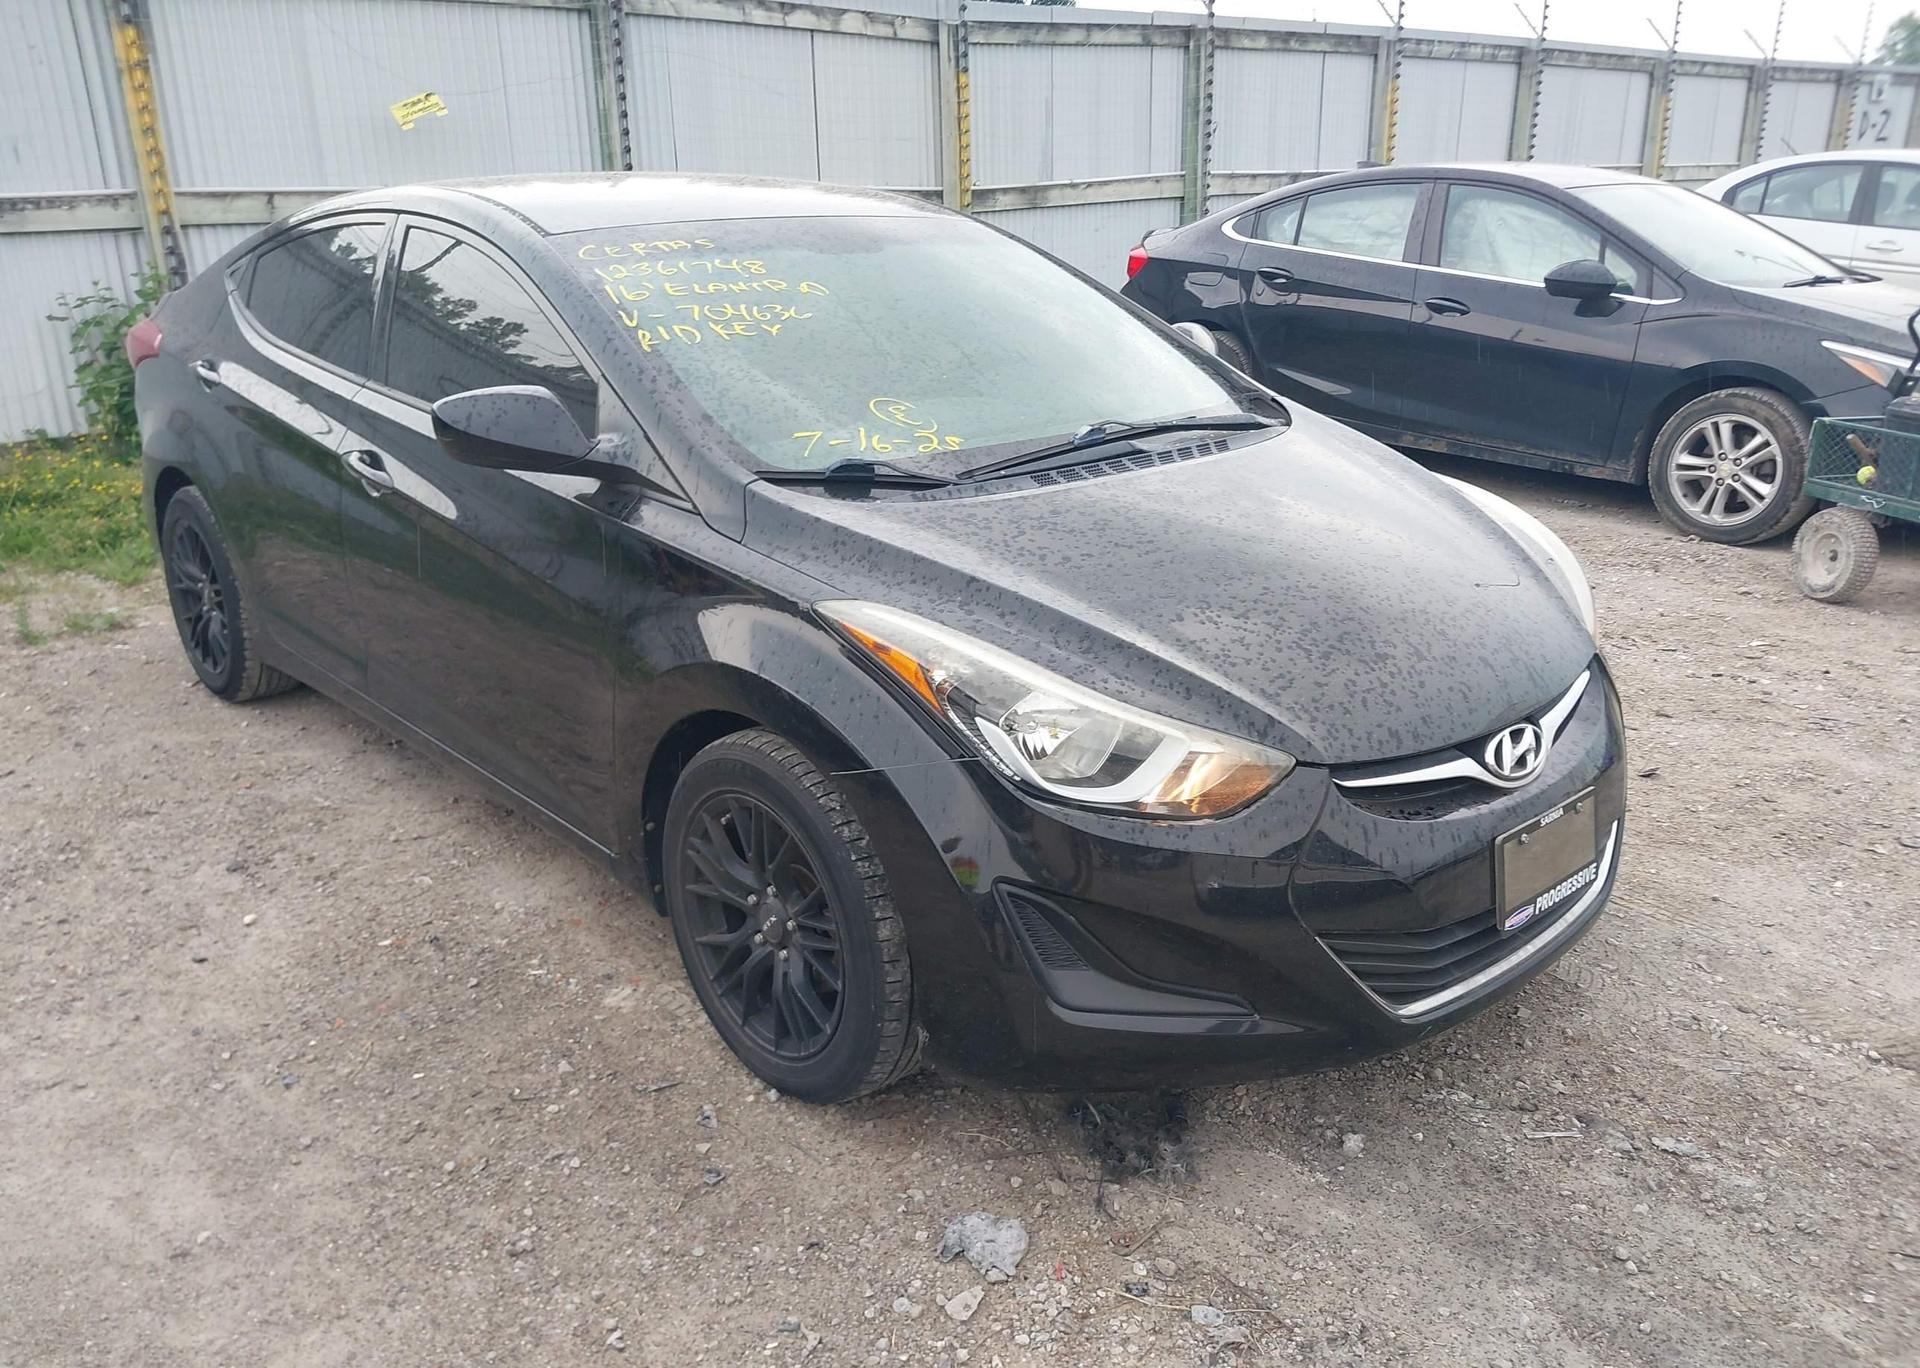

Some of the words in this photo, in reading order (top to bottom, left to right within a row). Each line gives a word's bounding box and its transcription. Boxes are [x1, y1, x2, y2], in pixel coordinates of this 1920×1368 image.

[594, 259, 767, 283] 12361748
[664, 279, 829, 297] ELANTRA
[709, 321, 782, 341] KEY
[1535, 862, 1598, 915] PROGRESSIVE
